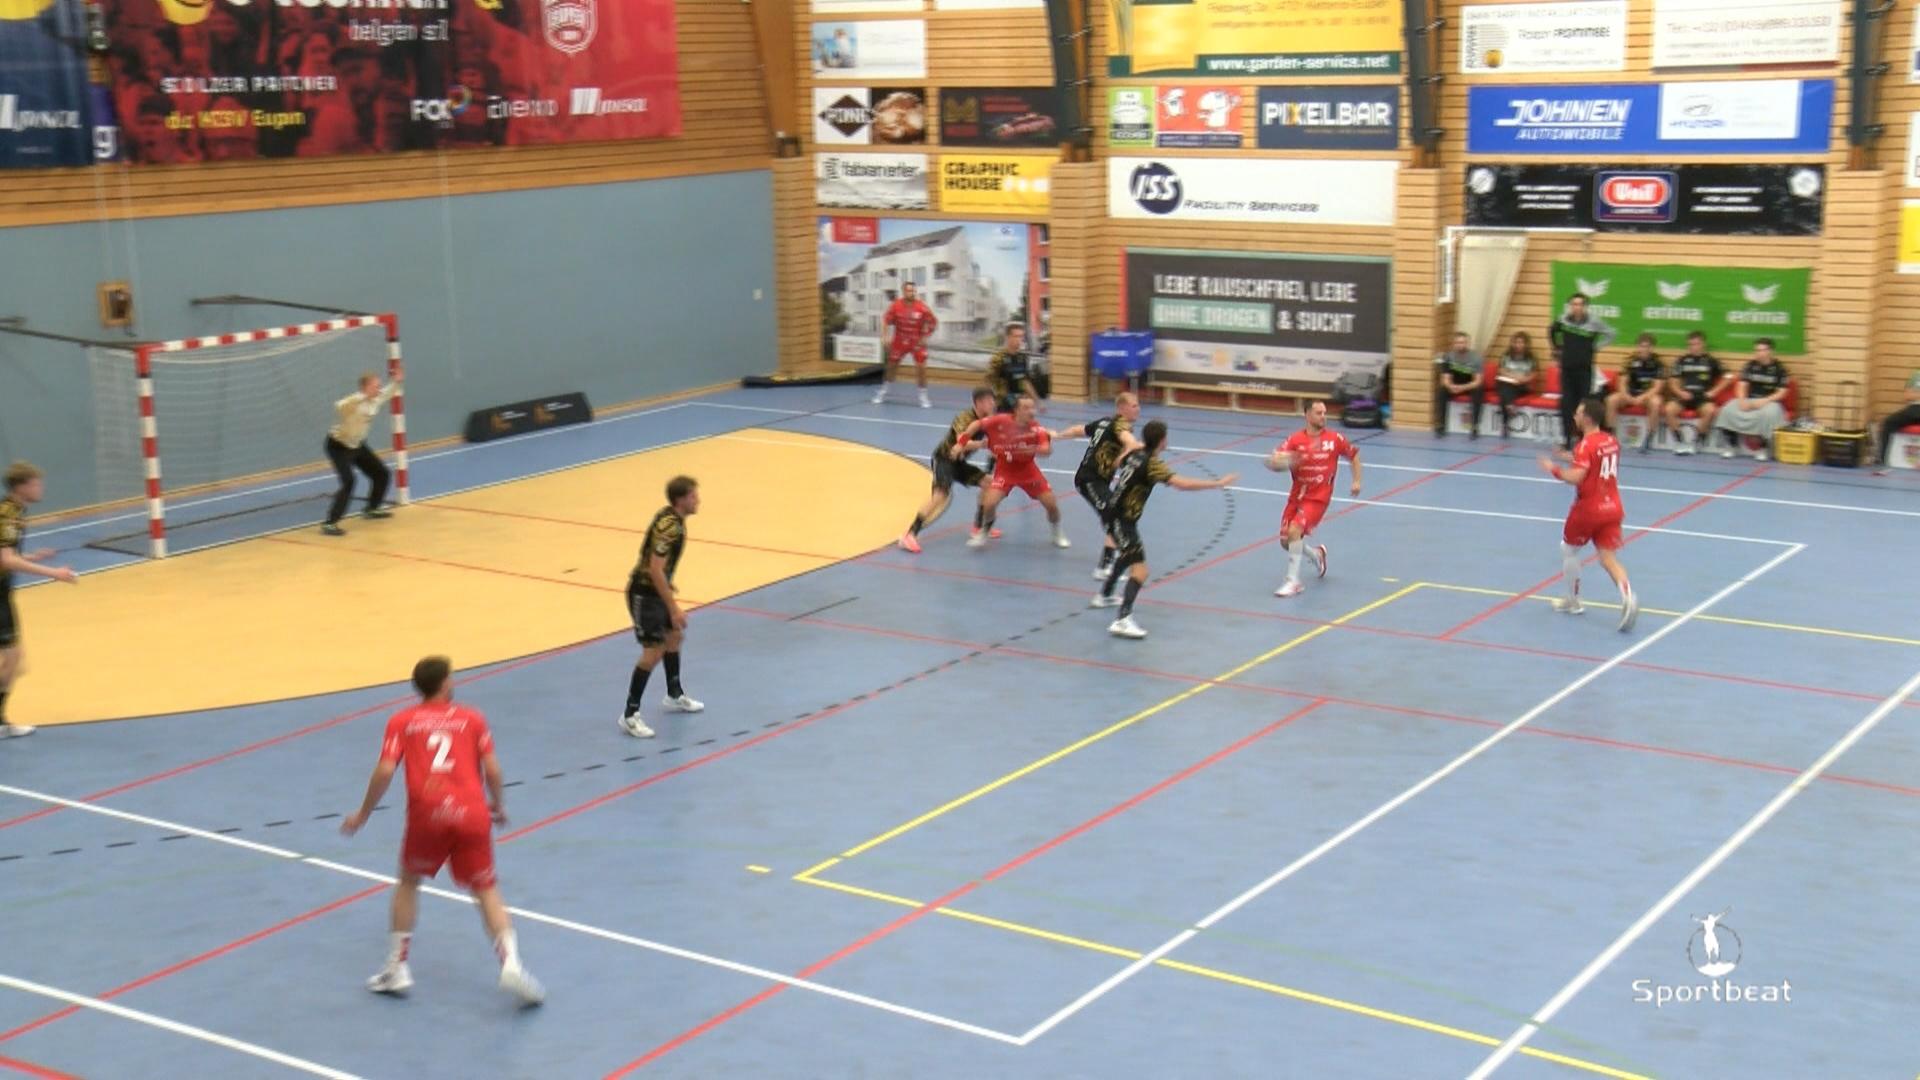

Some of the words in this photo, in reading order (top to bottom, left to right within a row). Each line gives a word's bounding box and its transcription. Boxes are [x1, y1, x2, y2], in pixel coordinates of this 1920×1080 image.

[1261, 100, 1393, 127] PIXELBAR
[1494, 98, 1633, 127] JOHNEN
[1515, 127, 1625, 140] AUTOMOBILE
[944, 162, 1019, 176] GRAPHIC
[944, 177, 1002, 191] HOUSE
[1132, 174, 1177, 201] ISS
[1153, 274, 1199, 296] LEBE
[1200, 276, 1309, 303] RAUSCHFREI,
[1311, 281, 1358, 303] LEBE
[1155, 303, 1200, 325] OHNE
[1205, 305, 1267, 328] DROGEN
[1276, 310, 1294, 331] &
[1298, 311, 1356, 334] SUCHT
[1643, 302, 1703, 322] erima
[1727, 308, 1790, 326] erima
[1599, 453, 1618, 480] 44
[426, 731, 457, 774] 2
